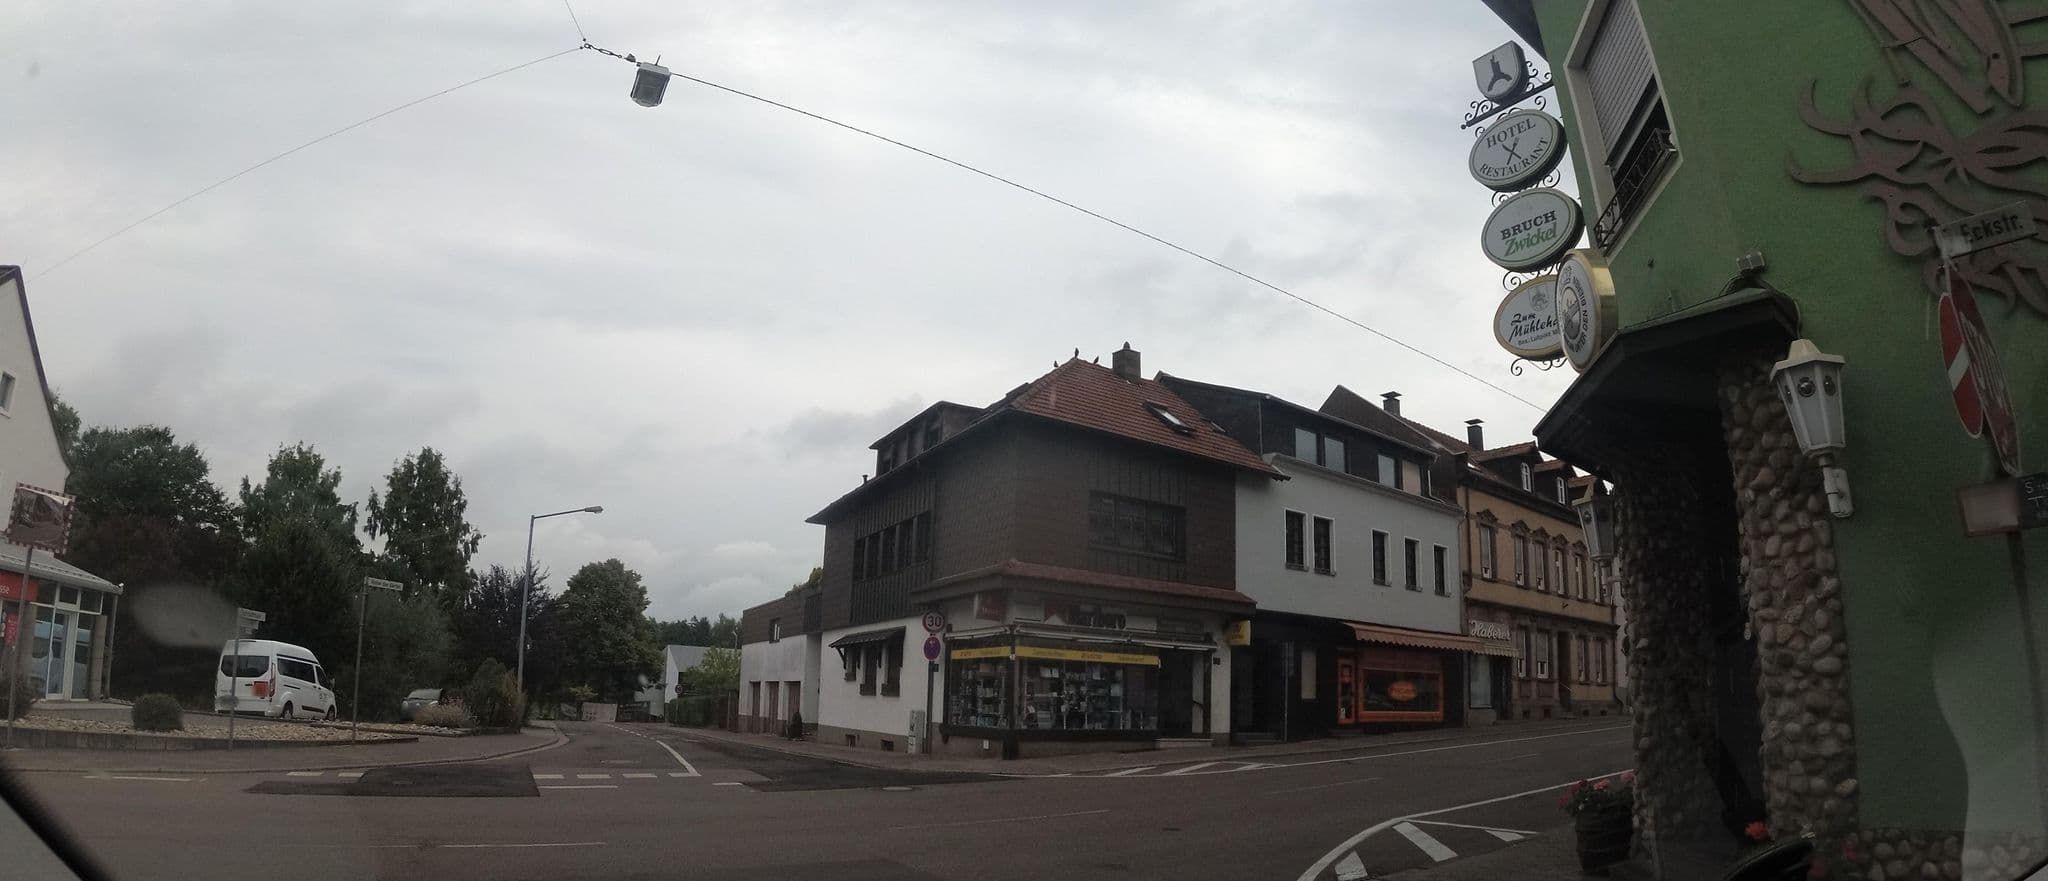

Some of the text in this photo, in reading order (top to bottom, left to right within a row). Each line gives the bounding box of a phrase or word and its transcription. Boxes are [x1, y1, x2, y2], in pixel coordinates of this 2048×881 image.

[1486, 118, 1536, 148] HOTEL
[1480, 137, 1548, 177] RESTAURANT
[1501, 210, 1557, 240] BRUCH
[1504, 222, 1558, 257] Zwickel
[1960, 213, 2023, 240] Eckstr.
[1511, 313, 1536, 326] Zum
[927, 615, 942, 628] 30
